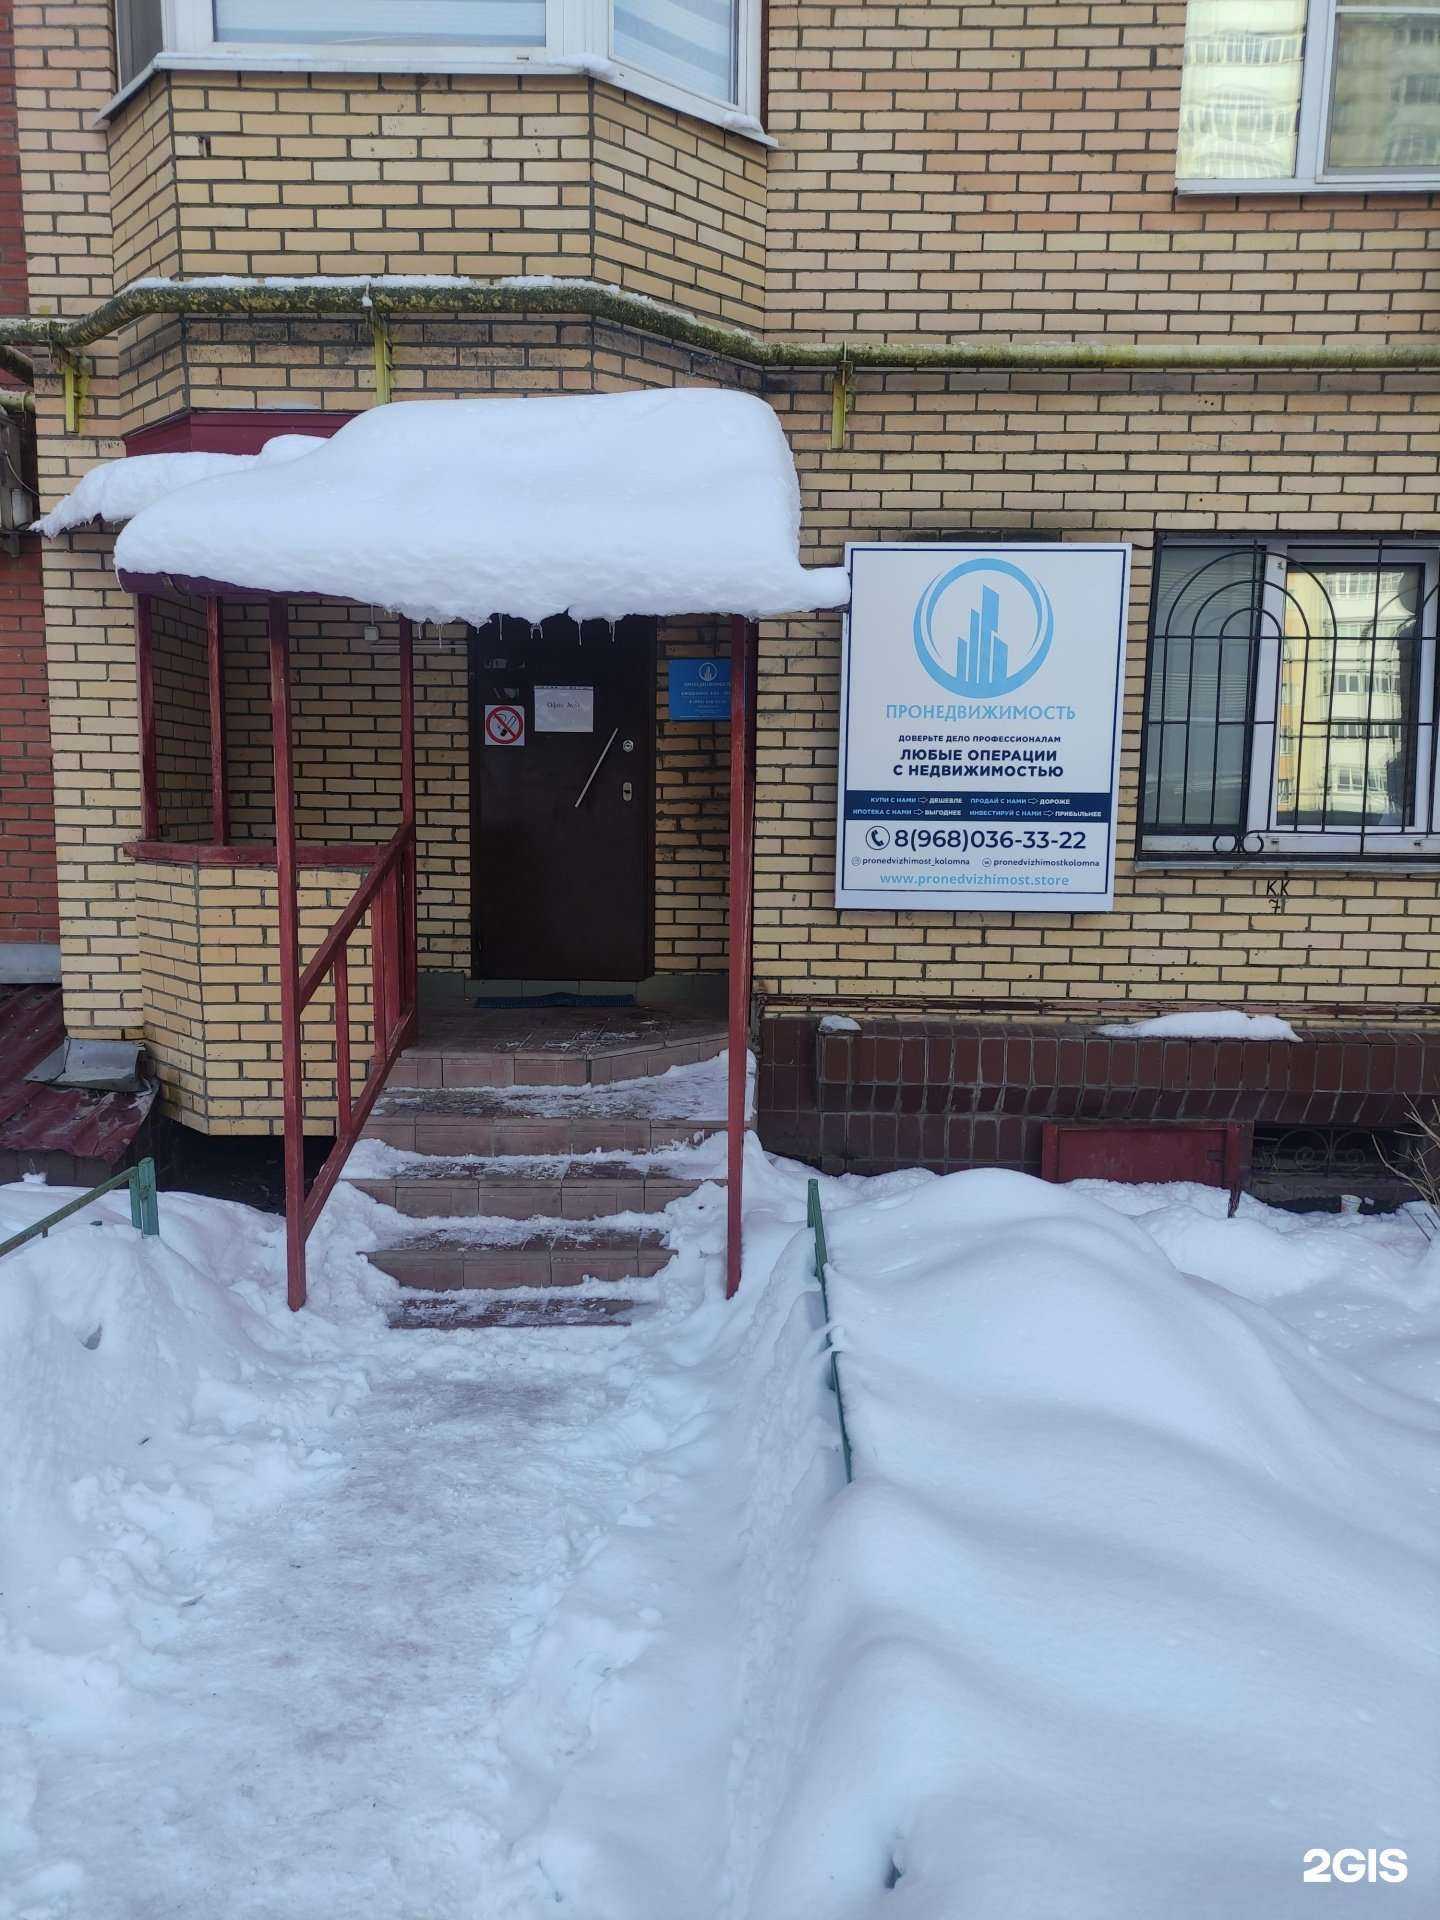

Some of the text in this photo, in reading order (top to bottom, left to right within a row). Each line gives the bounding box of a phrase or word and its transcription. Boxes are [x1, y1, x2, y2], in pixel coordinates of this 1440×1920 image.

[886, 704, 1076, 722] ПРОНЕДВИЖИМОСТЬ
[898, 735, 1061, 743] ДОВЕРЬТЕ ДЕЛО ПРОФЕССИОНАЛАМ
[900, 749, 1057, 763] ЛЮБЫЕ ОПЕРАЦИИ
[893, 765, 1064, 778] С НЕДВИЖИМОСТЬЮ
[894, 829, 1087, 852] 8(968)036-33-22
[862, 856, 970, 866] pronedvizhimost_kolomna
[993, 857, 1100, 867] pronedvizhimostkolomna
[880, 873, 1070, 888] www.pronedvizhimost.store
